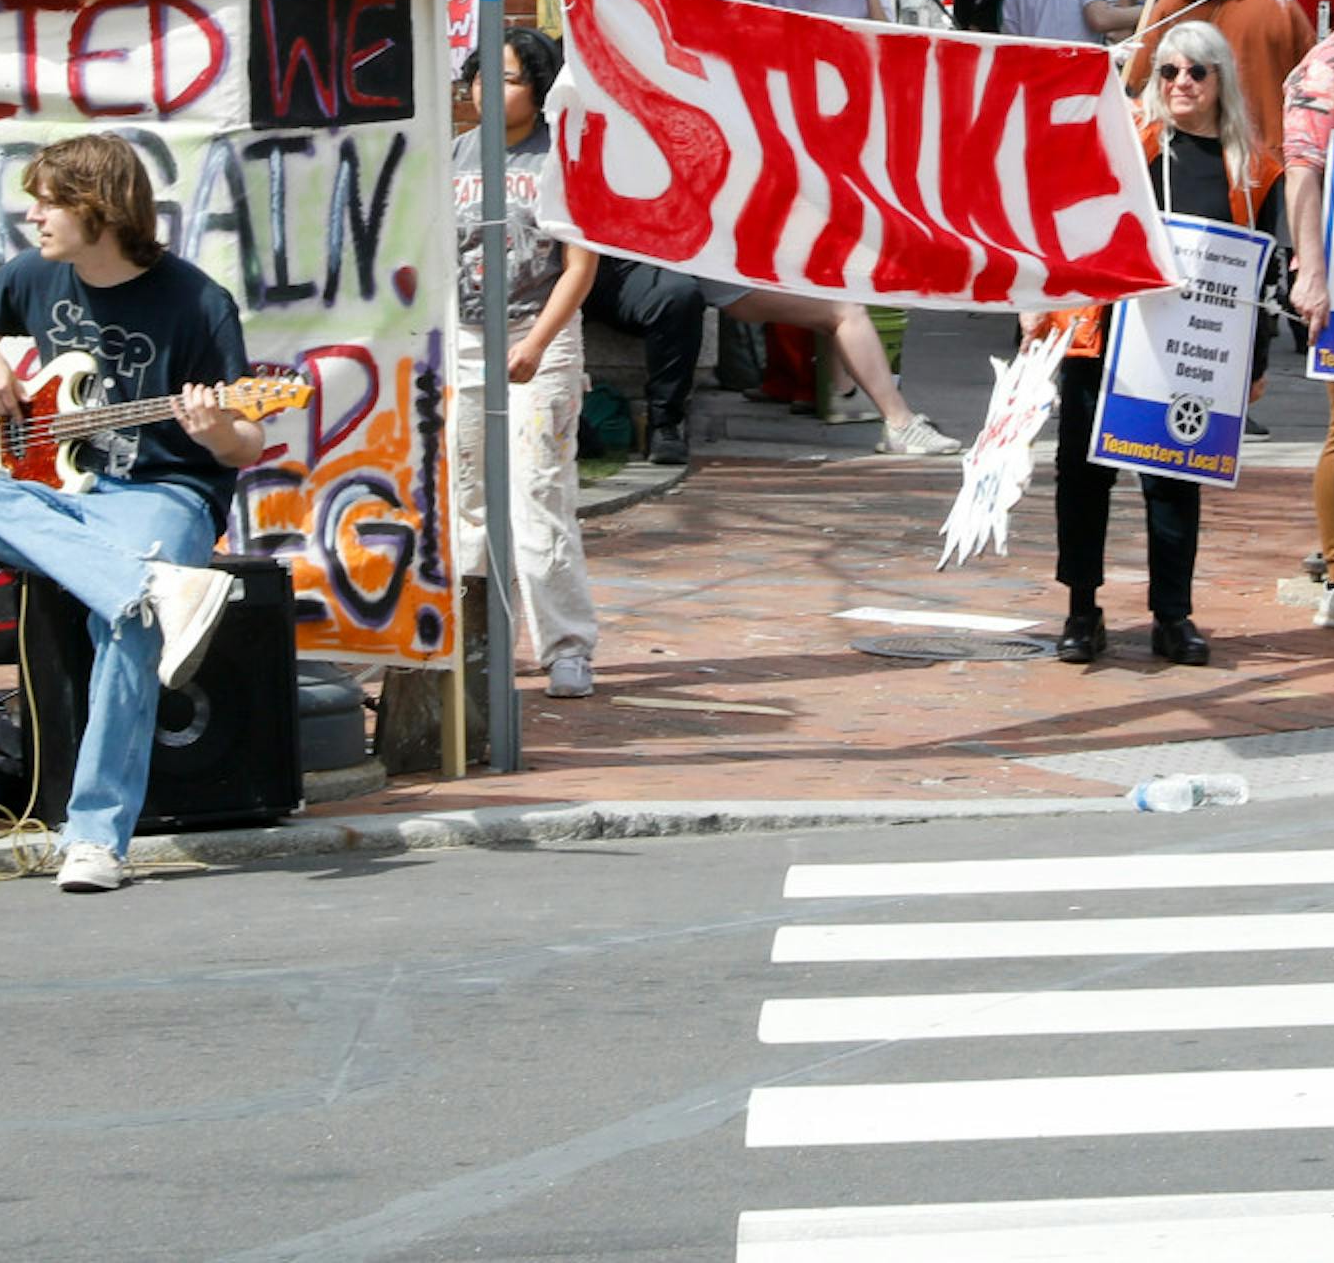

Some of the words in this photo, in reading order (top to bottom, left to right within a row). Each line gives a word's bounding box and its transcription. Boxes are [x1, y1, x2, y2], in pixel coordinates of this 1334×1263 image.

[1188, 314, 1223, 333] Against
[1166, 338, 1179, 354] RI
[1183, 341, 1218, 364] School
[1176, 362, 1214, 383] Design
[1101, 432, 1185, 466] Teamsters
[1187, 448, 1221, 472] Local
